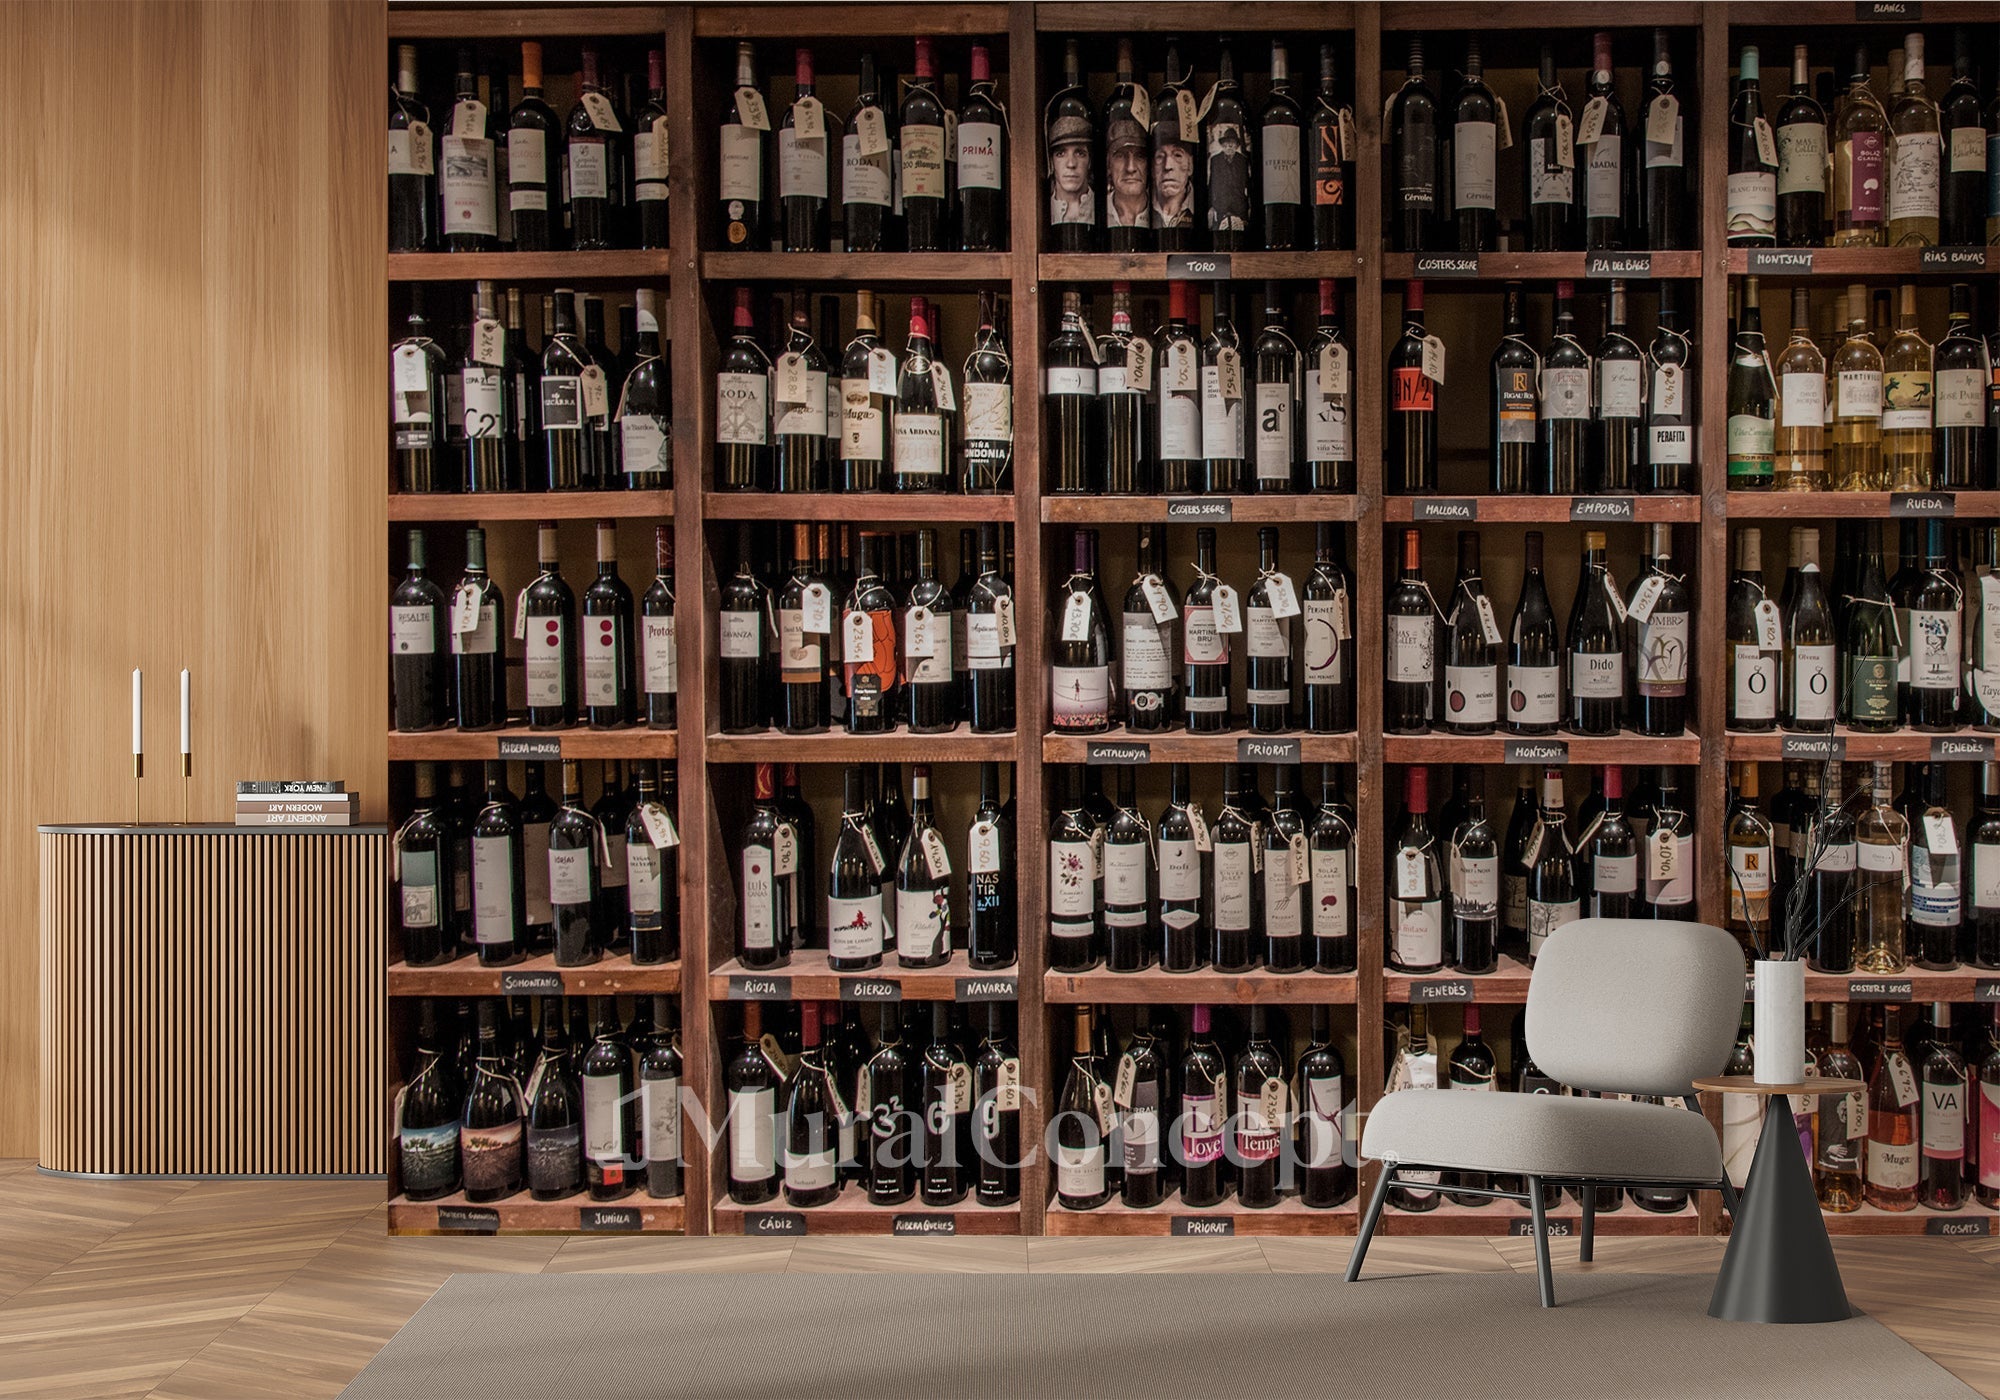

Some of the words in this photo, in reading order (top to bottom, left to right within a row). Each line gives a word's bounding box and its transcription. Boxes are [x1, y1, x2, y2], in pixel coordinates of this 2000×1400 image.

[1873, 3, 1906, 13] BLANCS
[962, 146, 994, 156] PRIMA
[846, 158, 873, 168] RODA
[1588, 161, 1618, 169] ABADAL
[1417, 259, 1455, 271] COSTERS
[1592, 259, 1609, 272] PLA
[1625, 259, 1650, 271] BAGES
[1757, 254, 1812, 266] MONTSANT
[1186, 261, 1216, 272] TORO
[719, 390, 755, 400] RODA
[1657, 430, 1686, 443] PERAFITA
[1169, 503, 1200, 515] COSTERS
[1201, 505, 1225, 514] SEGRE
[1576, 501, 1630, 516] EMPORDÀ
[1906, 498, 1943, 509] RUEDA
[1425, 504, 1470, 516] MALLORCA
[398, 613, 431, 625] RESALTE
[1737, 653, 1759, 661] Olvena
[1798, 653, 1821, 661] Olvena
[1590, 659, 1614, 671] Dido
[1941, 738, 1984, 753] PENEDÈS
[1093, 749, 1146, 760] CATALUNYA
[1515, 746, 1563, 758] MONTSANT
[284, 784, 304, 792] YORK
[305, 784, 322, 792] NEW
[269, 804, 284, 812] ART
[286, 804, 322, 812] MODERN
[266, 814, 285, 823] ART
[286, 814, 327, 823] ANCIENT
[976, 875, 999, 884] NAS
[977, 885, 995, 895] TIR
[505, 976, 559, 990] SOMONTANO
[1850, 984, 1886, 993] COSTERS
[967, 982, 1014, 996] NAVARRA
[1422, 982, 1466, 1000] PENEDÈS
[1932, 1091, 1958, 1110] VA
[1189, 1137, 1221, 1158] Jove
[1243, 1134, 1280, 1154] Temps
[1881, 1153, 1913, 1166] Muga
[1520, 1223, 1568, 1236] PEDÈS
[1943, 1223, 1980, 1234] ROSATS
